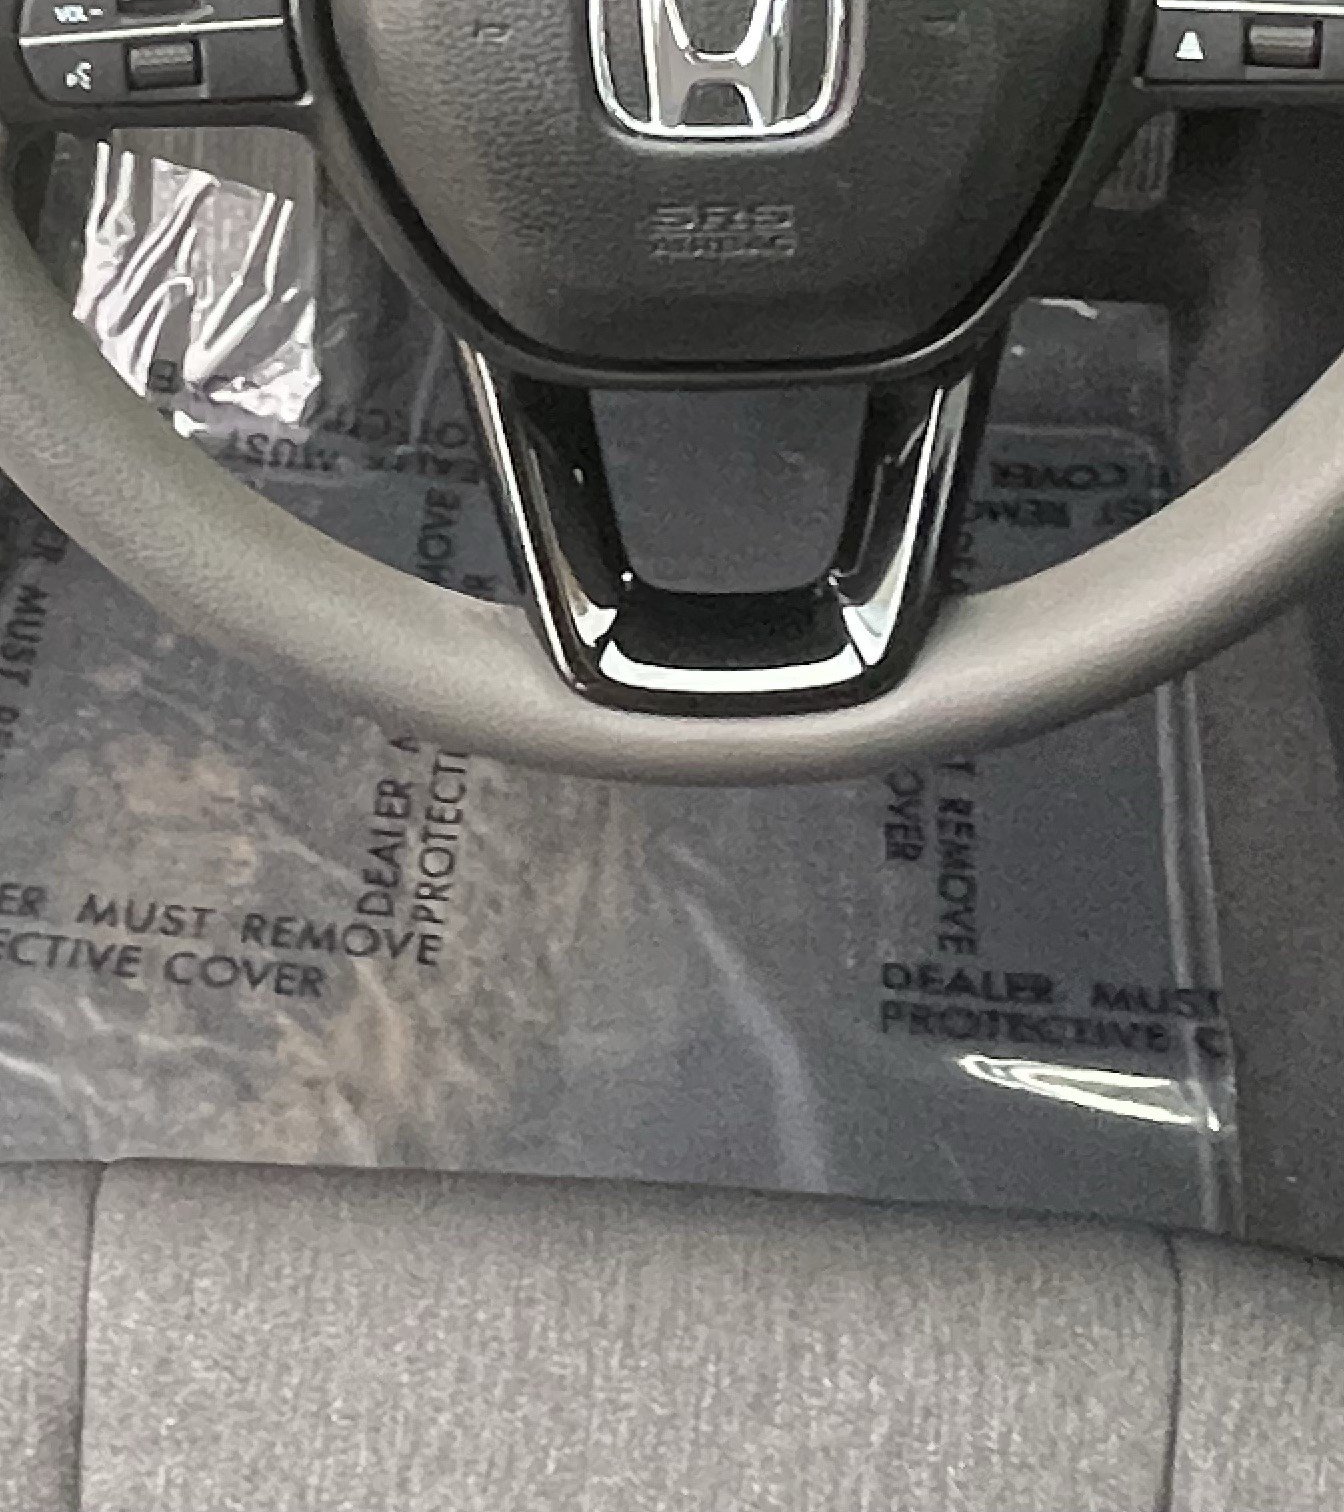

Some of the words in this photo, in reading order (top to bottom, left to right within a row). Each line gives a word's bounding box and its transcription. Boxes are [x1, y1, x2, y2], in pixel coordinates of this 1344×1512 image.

[356, 777, 416, 920] DEALER
[76, 894, 217, 942] MUST
[241, 913, 444, 968] REMOVE
[164, 950, 329, 999] COVER
[881, 962, 1054, 1002] DEALER
